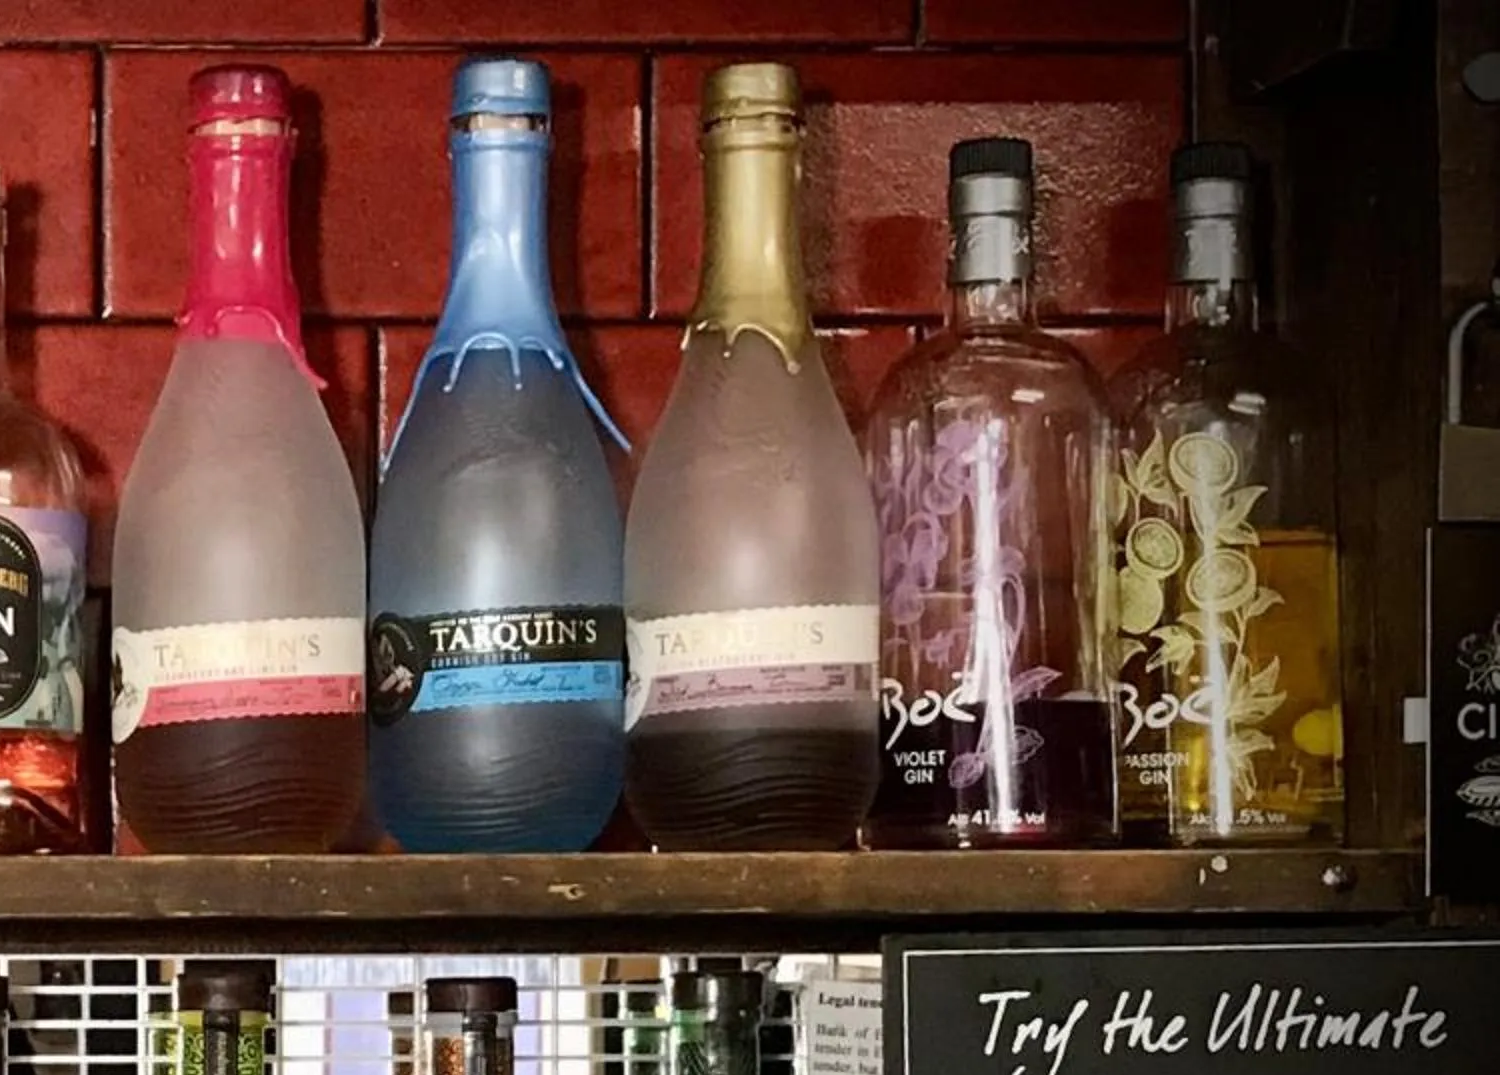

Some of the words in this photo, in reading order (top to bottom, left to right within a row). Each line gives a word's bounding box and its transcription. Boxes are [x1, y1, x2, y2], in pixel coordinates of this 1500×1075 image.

[429, 618, 598, 652] TARQUIN'S
[894, 749, 947, 767] VIOLET
[903, 769, 934, 784] GIN
[1139, 769, 1170, 785] GIN
[818, 992, 856, 1009] Legal
[1103, 988, 1189, 1056] the
[1206, 983, 1449, 1053] Ultimate
